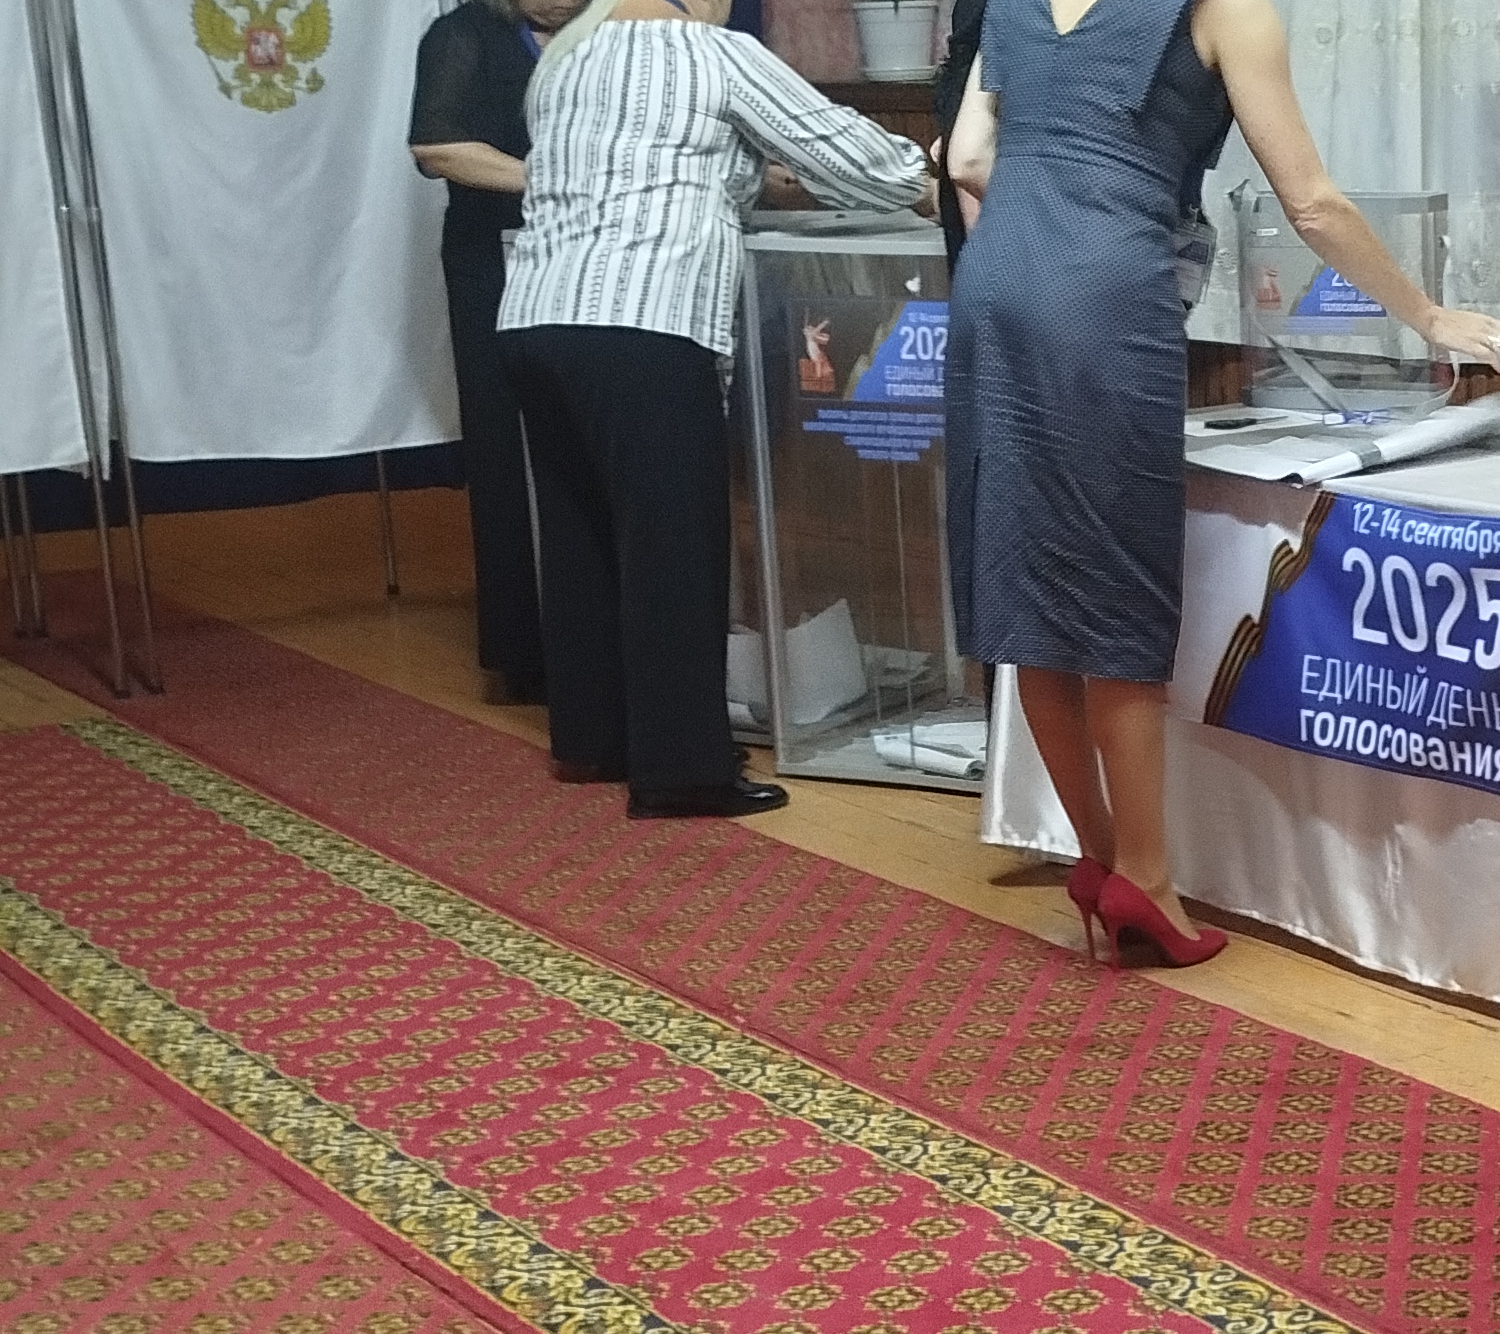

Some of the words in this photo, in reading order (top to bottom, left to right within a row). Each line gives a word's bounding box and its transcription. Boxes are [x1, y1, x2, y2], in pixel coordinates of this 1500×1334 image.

[900, 326, 949, 361] 202
[1352, 501, 1401, 540] 12-14
[1301, 654, 1427, 718] ЕДИНЫЙ
